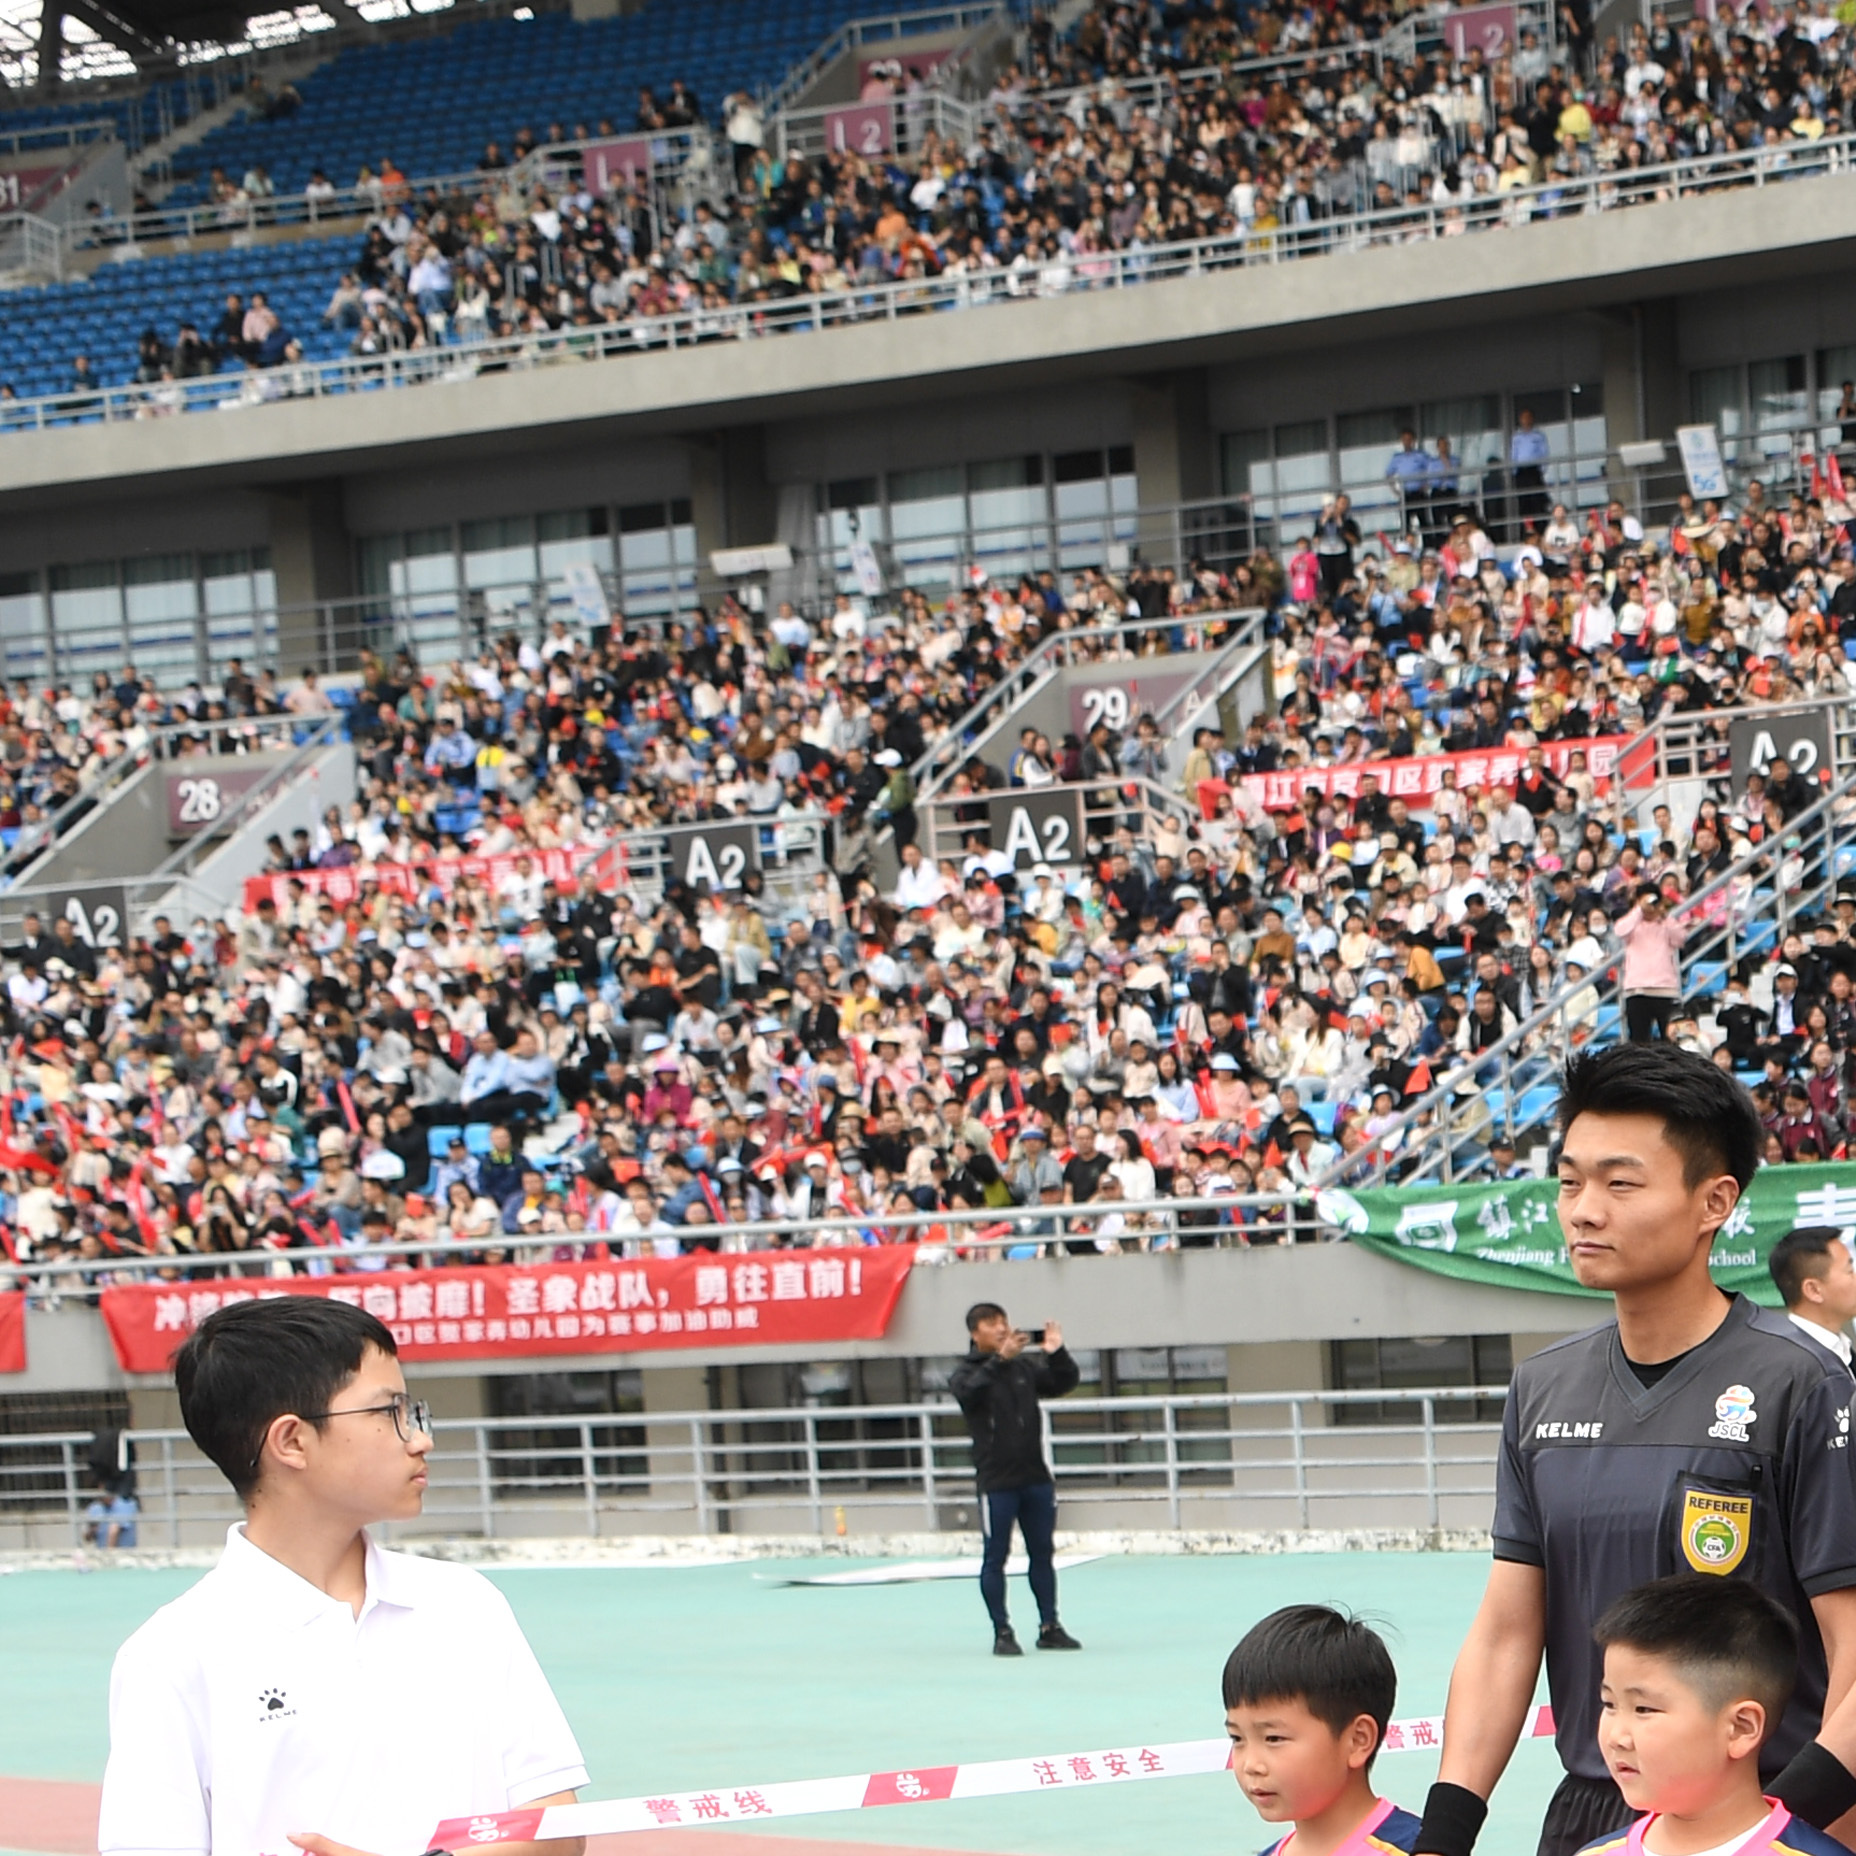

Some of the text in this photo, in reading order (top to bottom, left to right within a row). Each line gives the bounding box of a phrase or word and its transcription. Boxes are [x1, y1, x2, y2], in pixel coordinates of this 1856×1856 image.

[178, 778, 221, 823] 28
[1004, 806, 1071, 862] A2
[685, 836, 746, 890] A2
[65, 897, 121, 948] A2
[1535, 1422, 1604, 1440] KELME
[1708, 1421, 1751, 1443] JSCL
[1688, 1495, 1749, 1515] REFEREE
[643, 1790, 774, 1824] 警戒线
[1033, 1747, 1165, 1787] 注意安全
